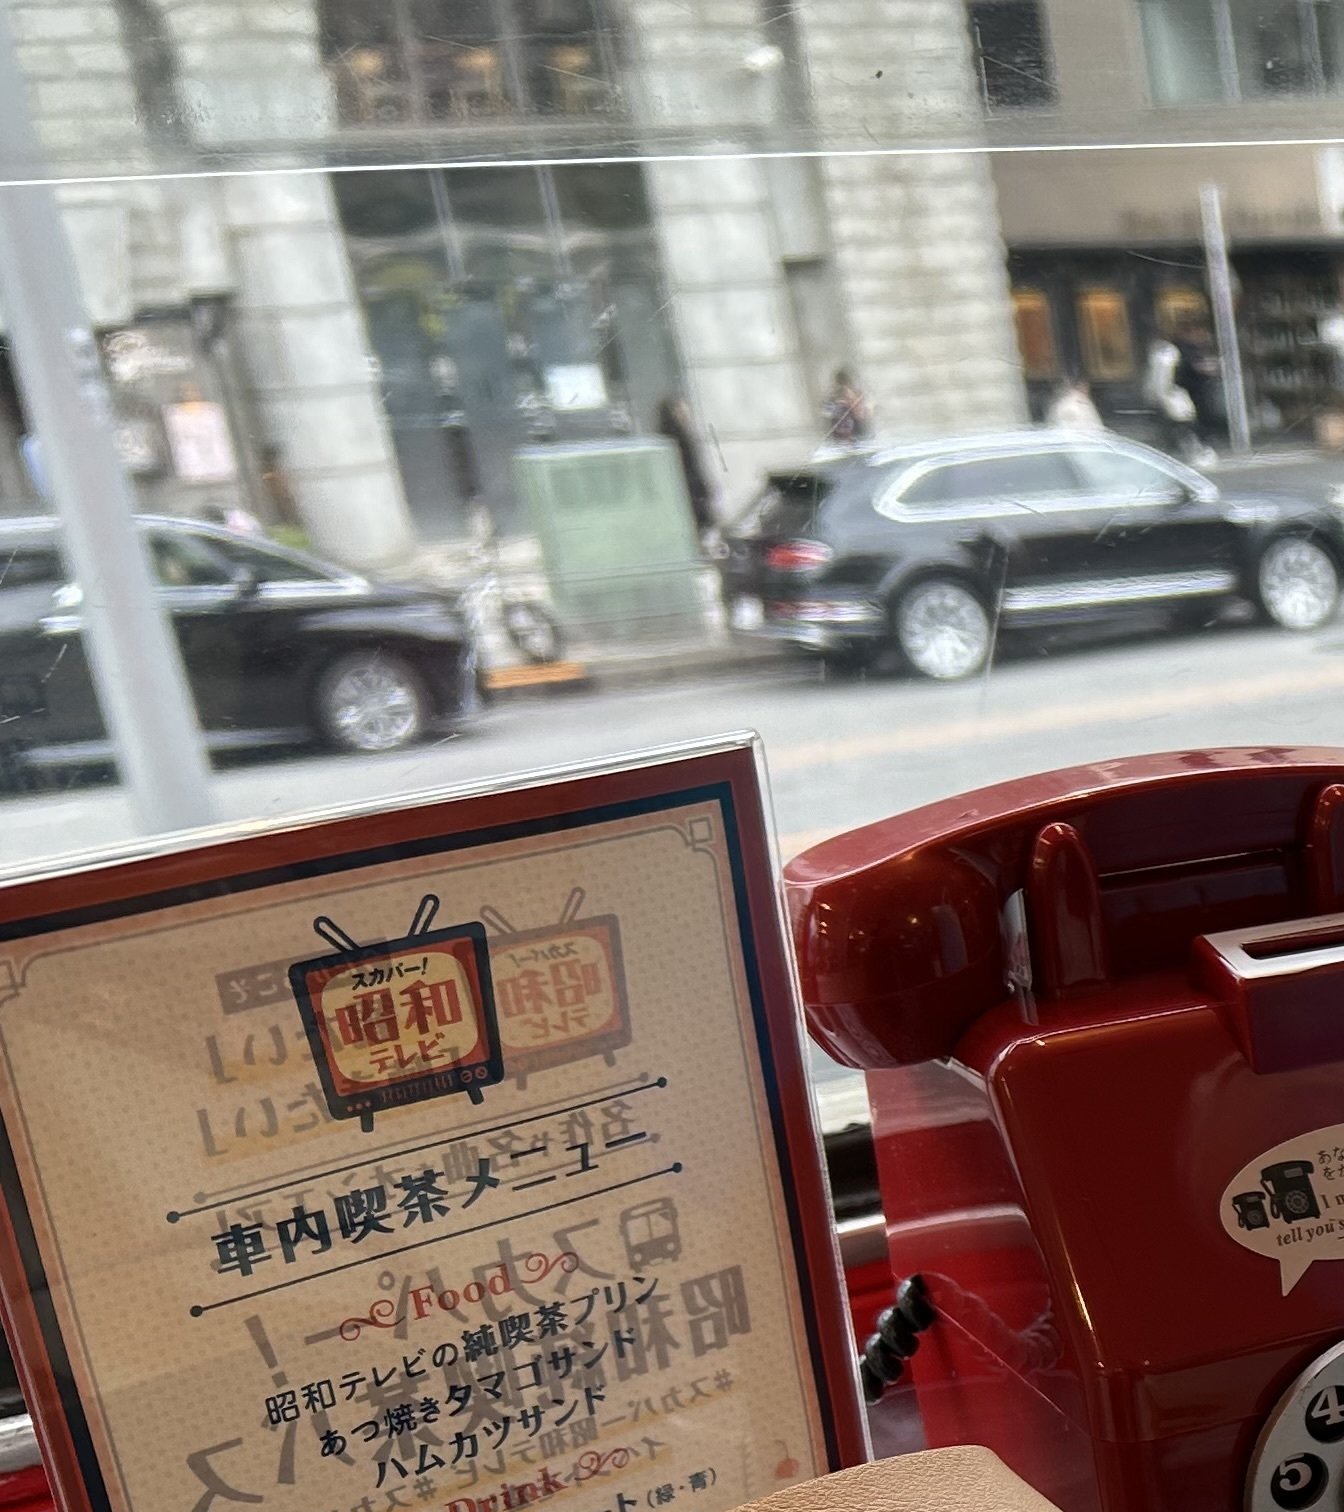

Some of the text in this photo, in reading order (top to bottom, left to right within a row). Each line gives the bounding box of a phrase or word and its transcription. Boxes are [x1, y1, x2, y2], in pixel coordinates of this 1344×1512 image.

[335, 979, 463, 1047] 昭和
[369, 1031, 446, 1074] テレビ
[211, 1131, 647, 1277] 車内喫茶メニュー
[1319, 1194, 1331, 1209] I
[1276, 1227, 1303, 1247] tell
[408, 1265, 516, 1321] Food
[264, 1275, 660, 1426] 昭和テレビの純喫茶プリン
[320, 1326, 637, 1458] あつ焼きタマゴサンド
[375, 1384, 606, 1489] ハムカツサンド
[1279, 1453, 1312, 1491] 5
